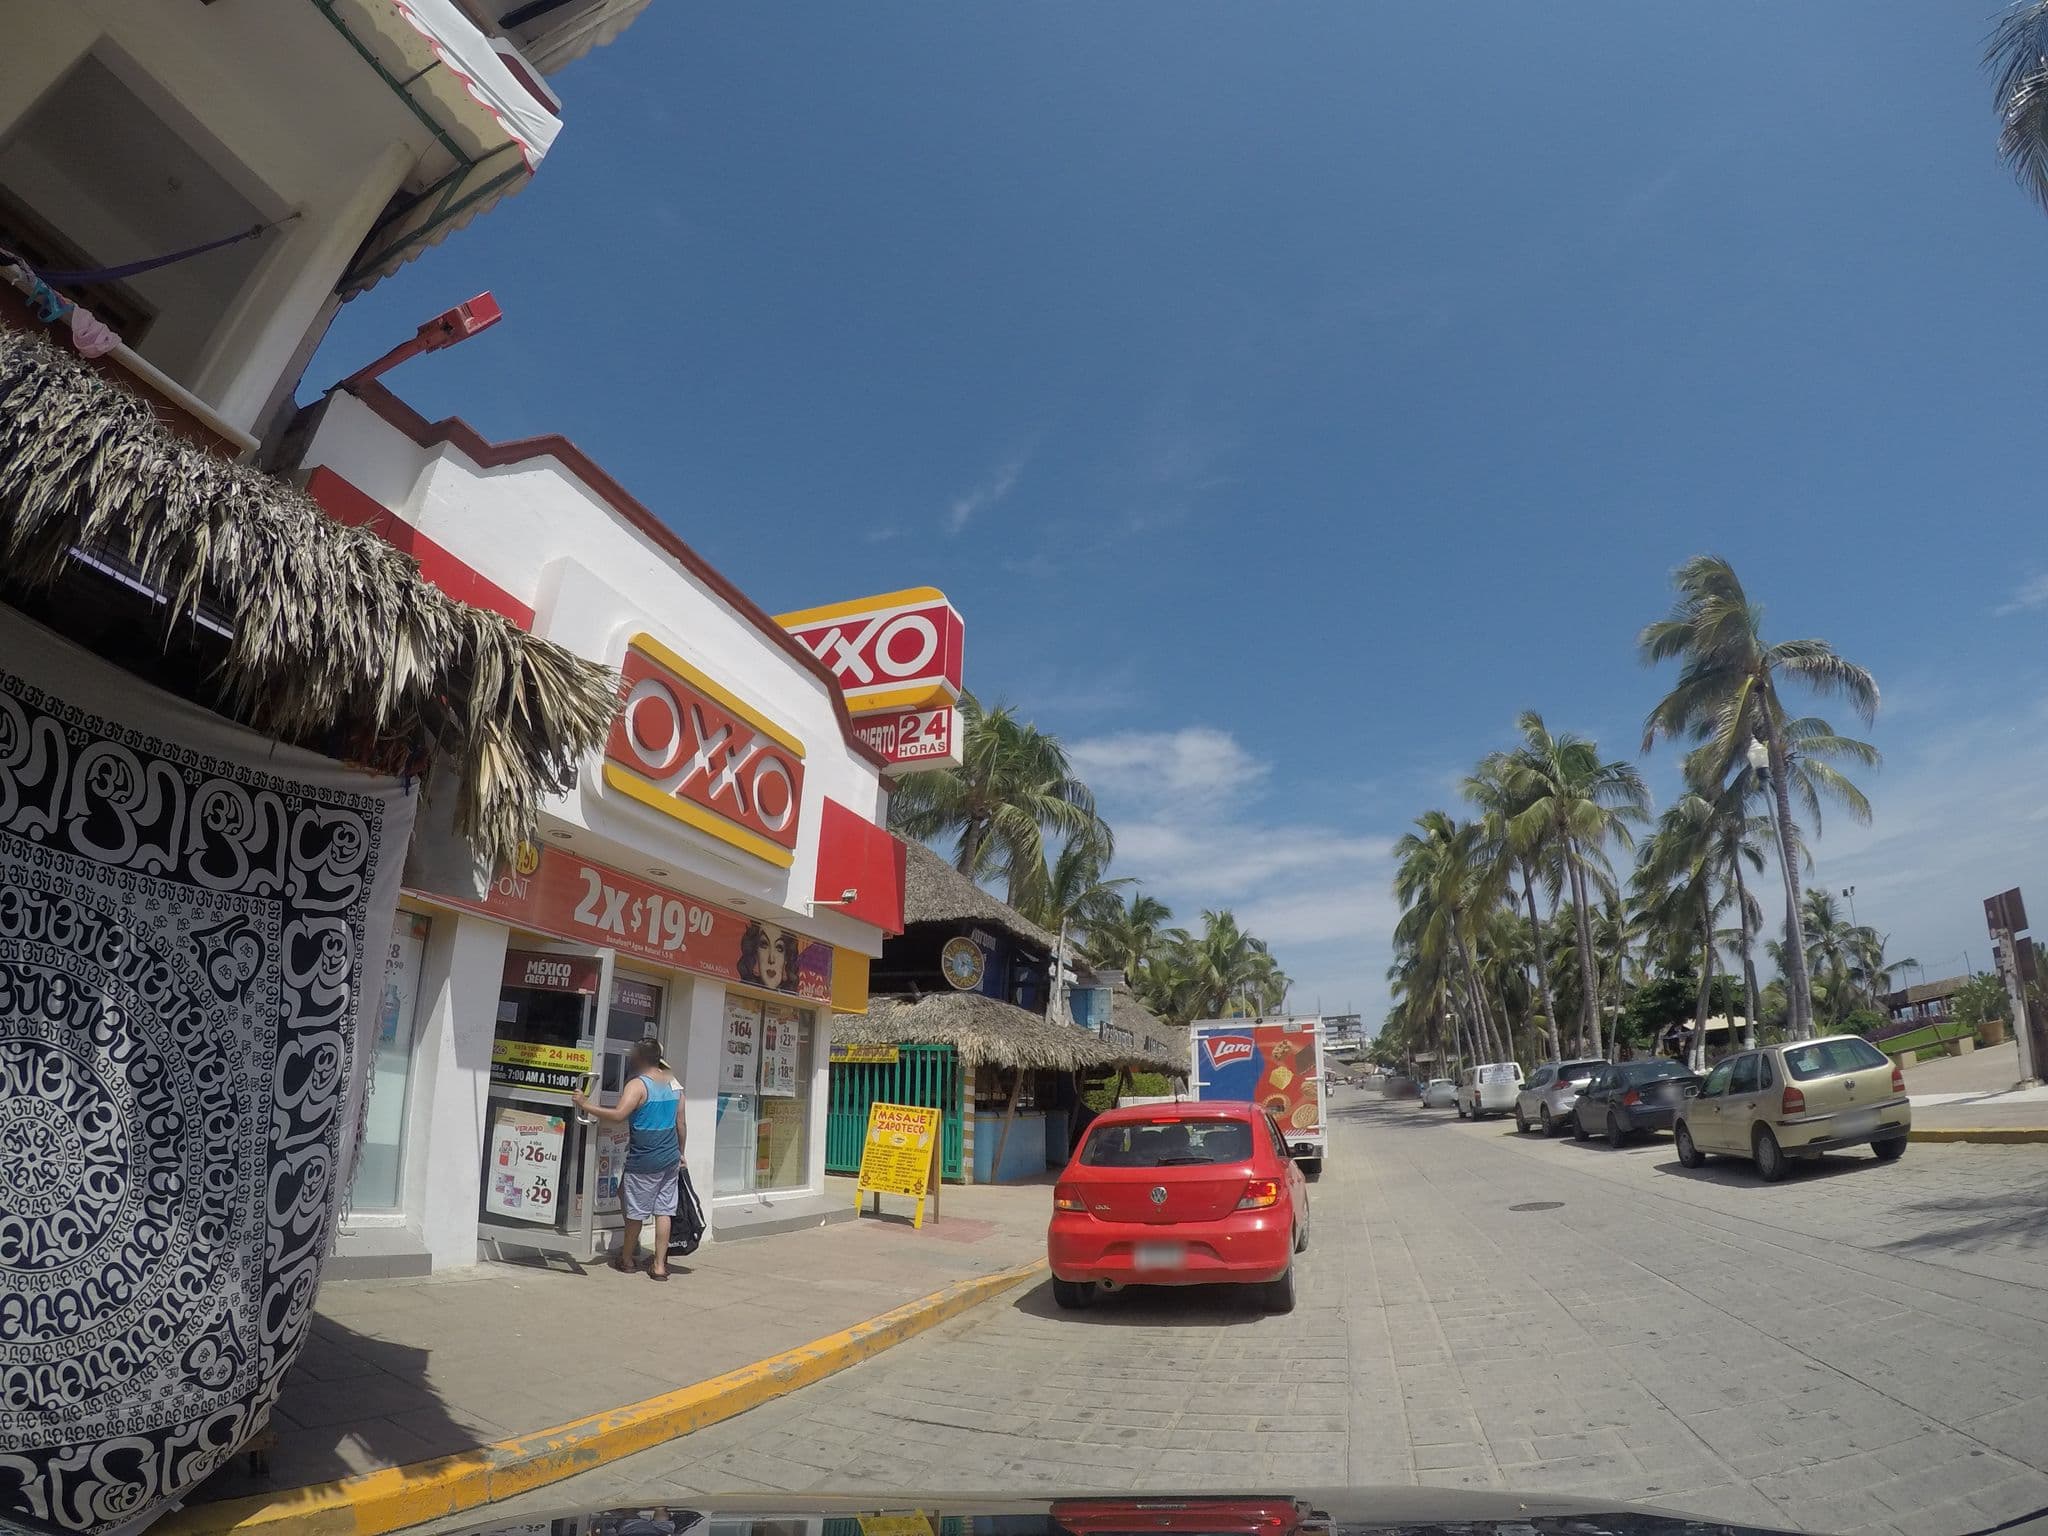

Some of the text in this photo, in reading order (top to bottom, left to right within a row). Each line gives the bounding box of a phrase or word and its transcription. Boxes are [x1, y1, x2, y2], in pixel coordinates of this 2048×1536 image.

[900, 712, 945, 745] 24
[625, 678, 793, 832] OXXO
[900, 741, 945, 756] HORAS
[573, 867, 630, 936] 2X
[526, 959, 572, 977] MÉXICO
[524, 973, 570, 988] CREO EN TI
[549, 1049, 562, 1060] 24
[566, 1052, 588, 1063] HRS.
[1214, 1040, 1251, 1059] Lara
[507, 1068, 524, 1081] 7:00
[525, 1070, 539, 1084] AM
[539, 1073, 545, 1084] A
[547, 1073, 569, 1087] 11:00
[878, 1110, 927, 1124] MASAJE
[514, 1125, 544, 1133] VERANO
[877, 1121, 925, 1135] ZAPOTECO
[525, 1185, 552, 1205] $29
